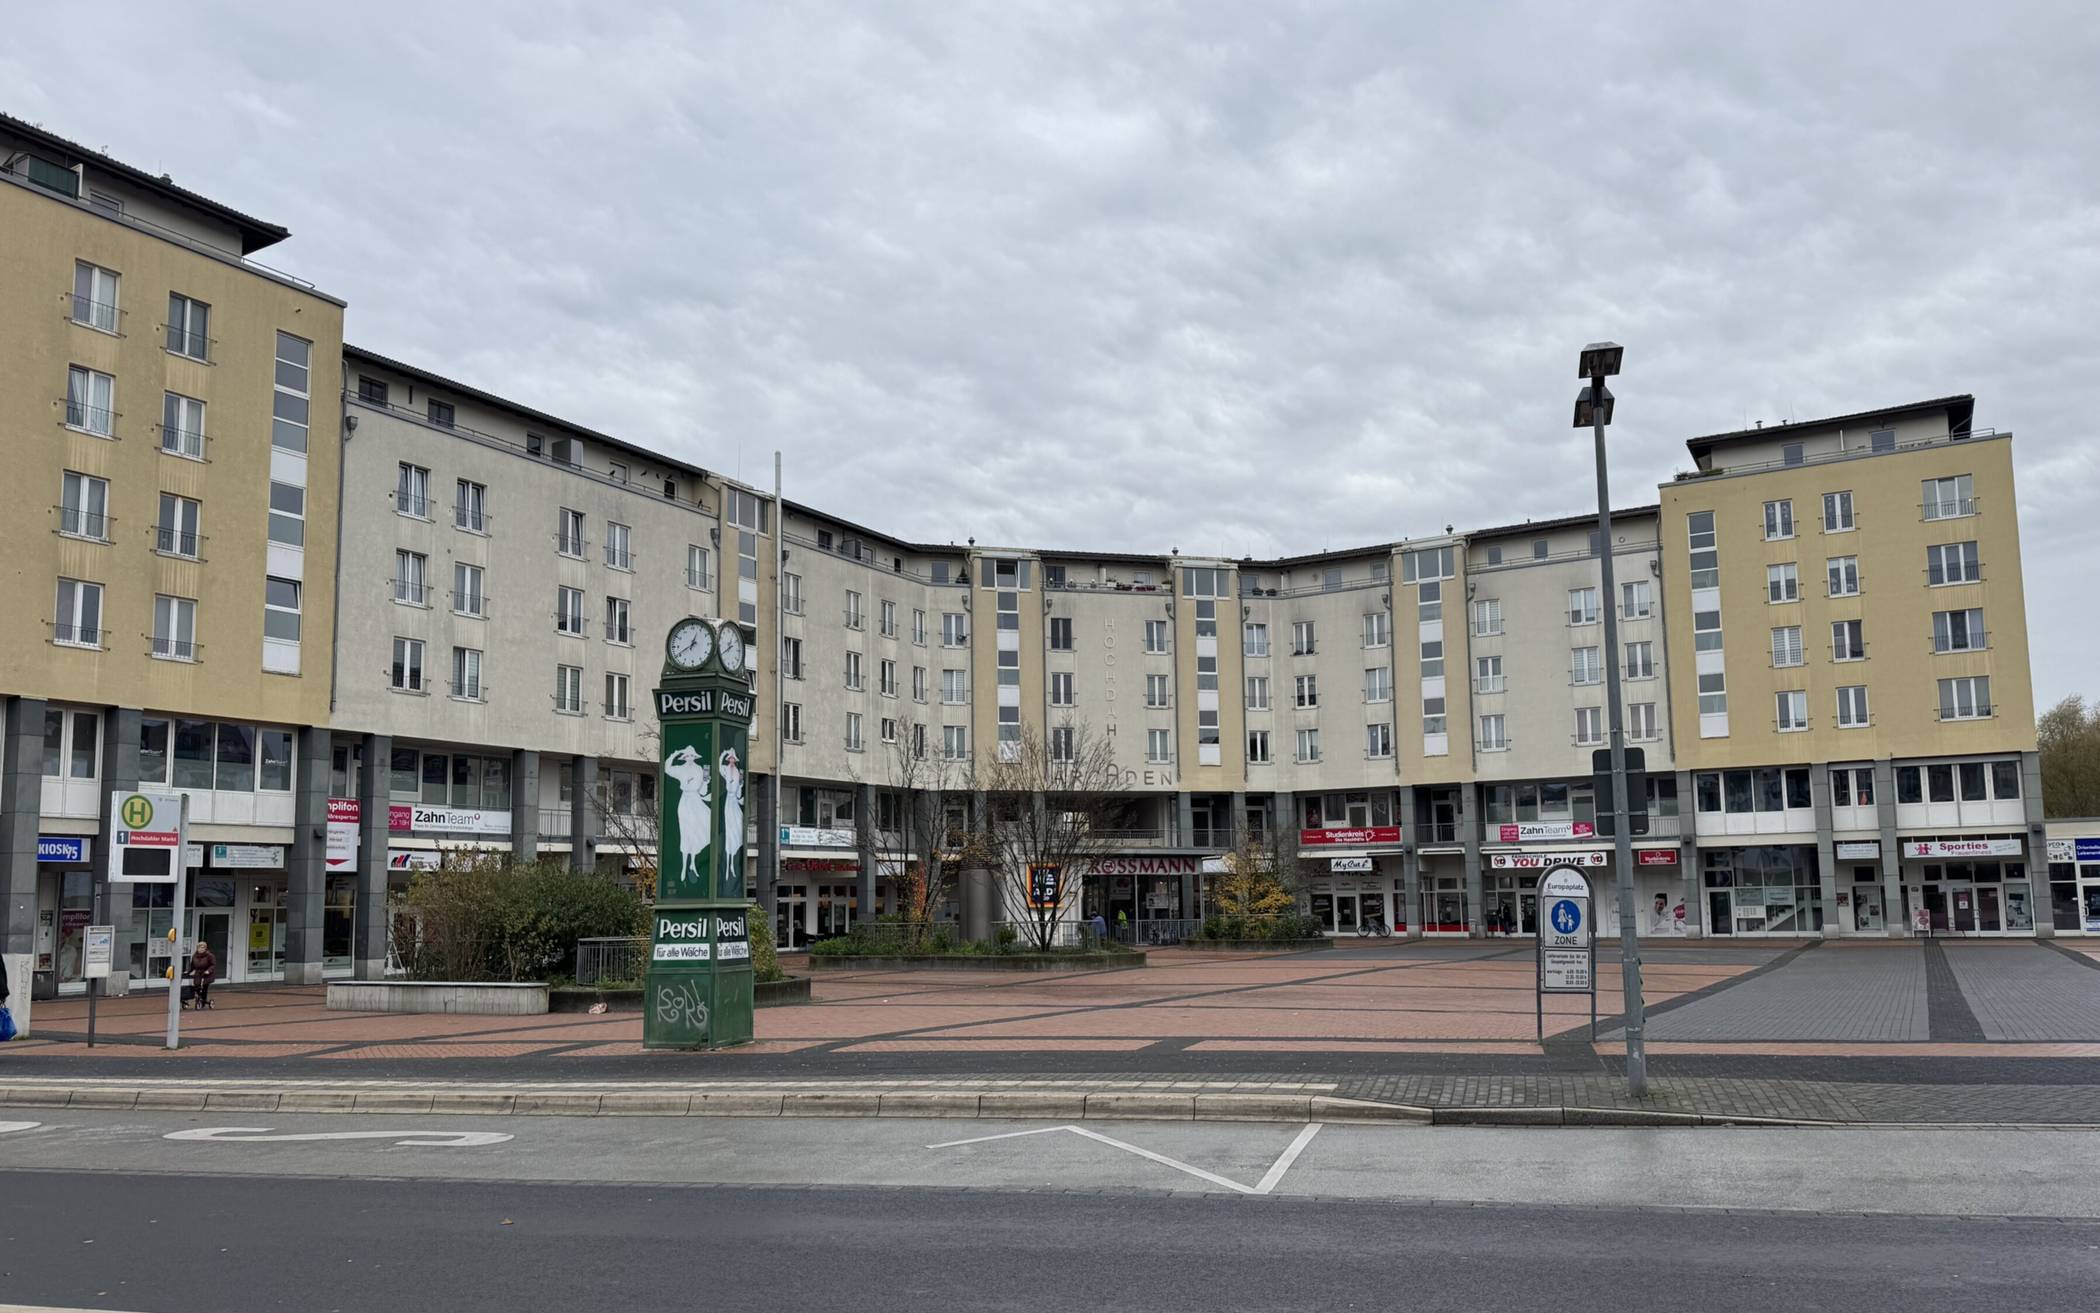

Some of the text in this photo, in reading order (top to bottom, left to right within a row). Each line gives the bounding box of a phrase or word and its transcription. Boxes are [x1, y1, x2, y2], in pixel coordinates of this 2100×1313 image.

[661, 691, 711, 713] Persil
[721, 691, 750, 717] Persil
[1054, 763, 1172, 785] ARADEN
[129, 801, 146, 823] H
[119, 832, 125, 843] 1
[1325, 830, 1364, 839] Studienkreis
[1939, 842, 1988, 852] Sporties
[1088, 857, 1196, 874] ROSSMANN
[1512, 856, 1586, 867] YOU DRIVE
[1547, 882, 1584, 891] Europaplatz
[659, 917, 708, 938] Persil
[716, 916, 745, 937] Persil
[1555, 936, 1578, 945] ZONE
[657, 947, 666, 957] für
[666, 947, 680, 958] alle
